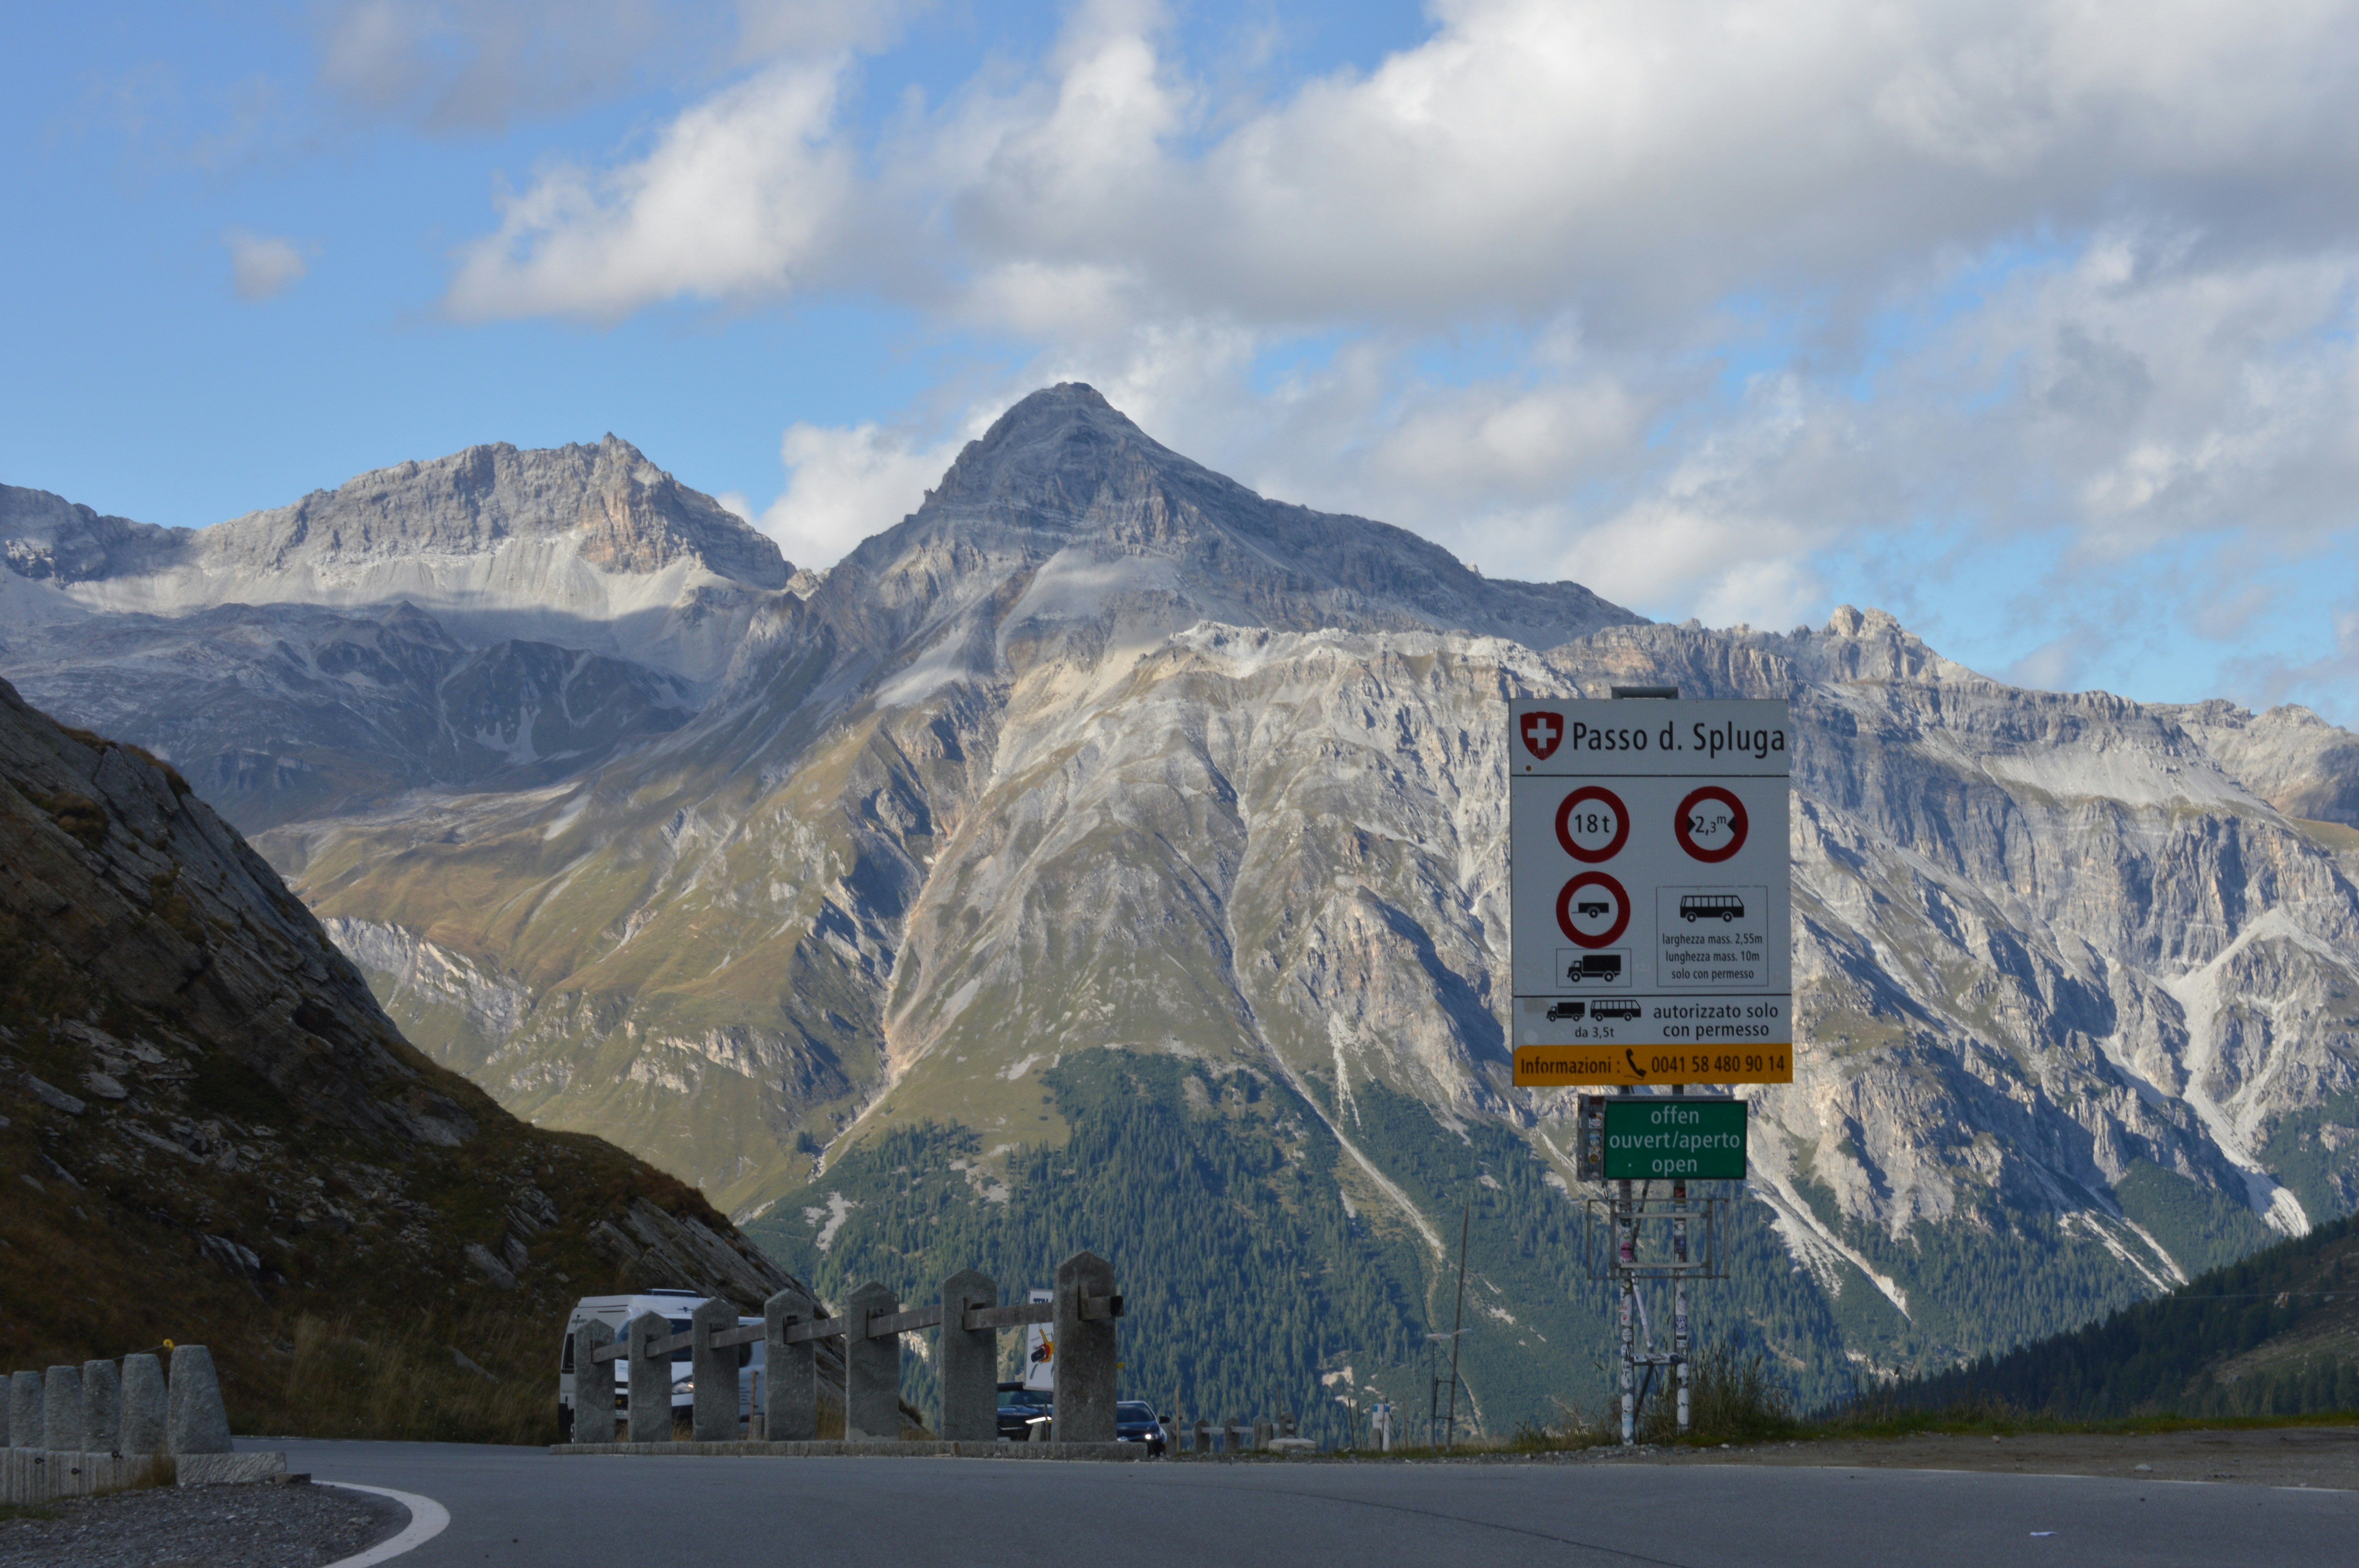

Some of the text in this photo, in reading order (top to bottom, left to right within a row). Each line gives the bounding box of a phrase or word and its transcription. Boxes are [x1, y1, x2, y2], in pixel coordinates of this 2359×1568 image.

[1573, 720, 1785, 759] Passo d. Spluga
[1575, 814, 1610, 833] 18t
[1663, 933, 1763, 946] larghezza mass. 2,55m
[1666, 950, 1759, 965] lunghezza mass. 10m
[1672, 967, 1754, 982] solo con permesso
[1653, 1002, 1778, 1019] autorizzato solo
[1575, 1026, 1614, 1039] da 3,5t
[1663, 1025, 1769, 1041] con permesso
[1521, 1056, 1611, 1074] Informazioni
[1652, 1056, 1685, 1073] 0041
[1692, 1055, 1709, 1073] 58
[1714, 1055, 1740, 1073] 480
[1745, 1054, 1763, 1072] 90
[1768, 1054, 1785, 1072] 14
[1651, 1105, 1699, 1124] offen
[1609, 1131, 1740, 1153] ouvert/aperto
[1652, 1159, 1697, 1177] open
